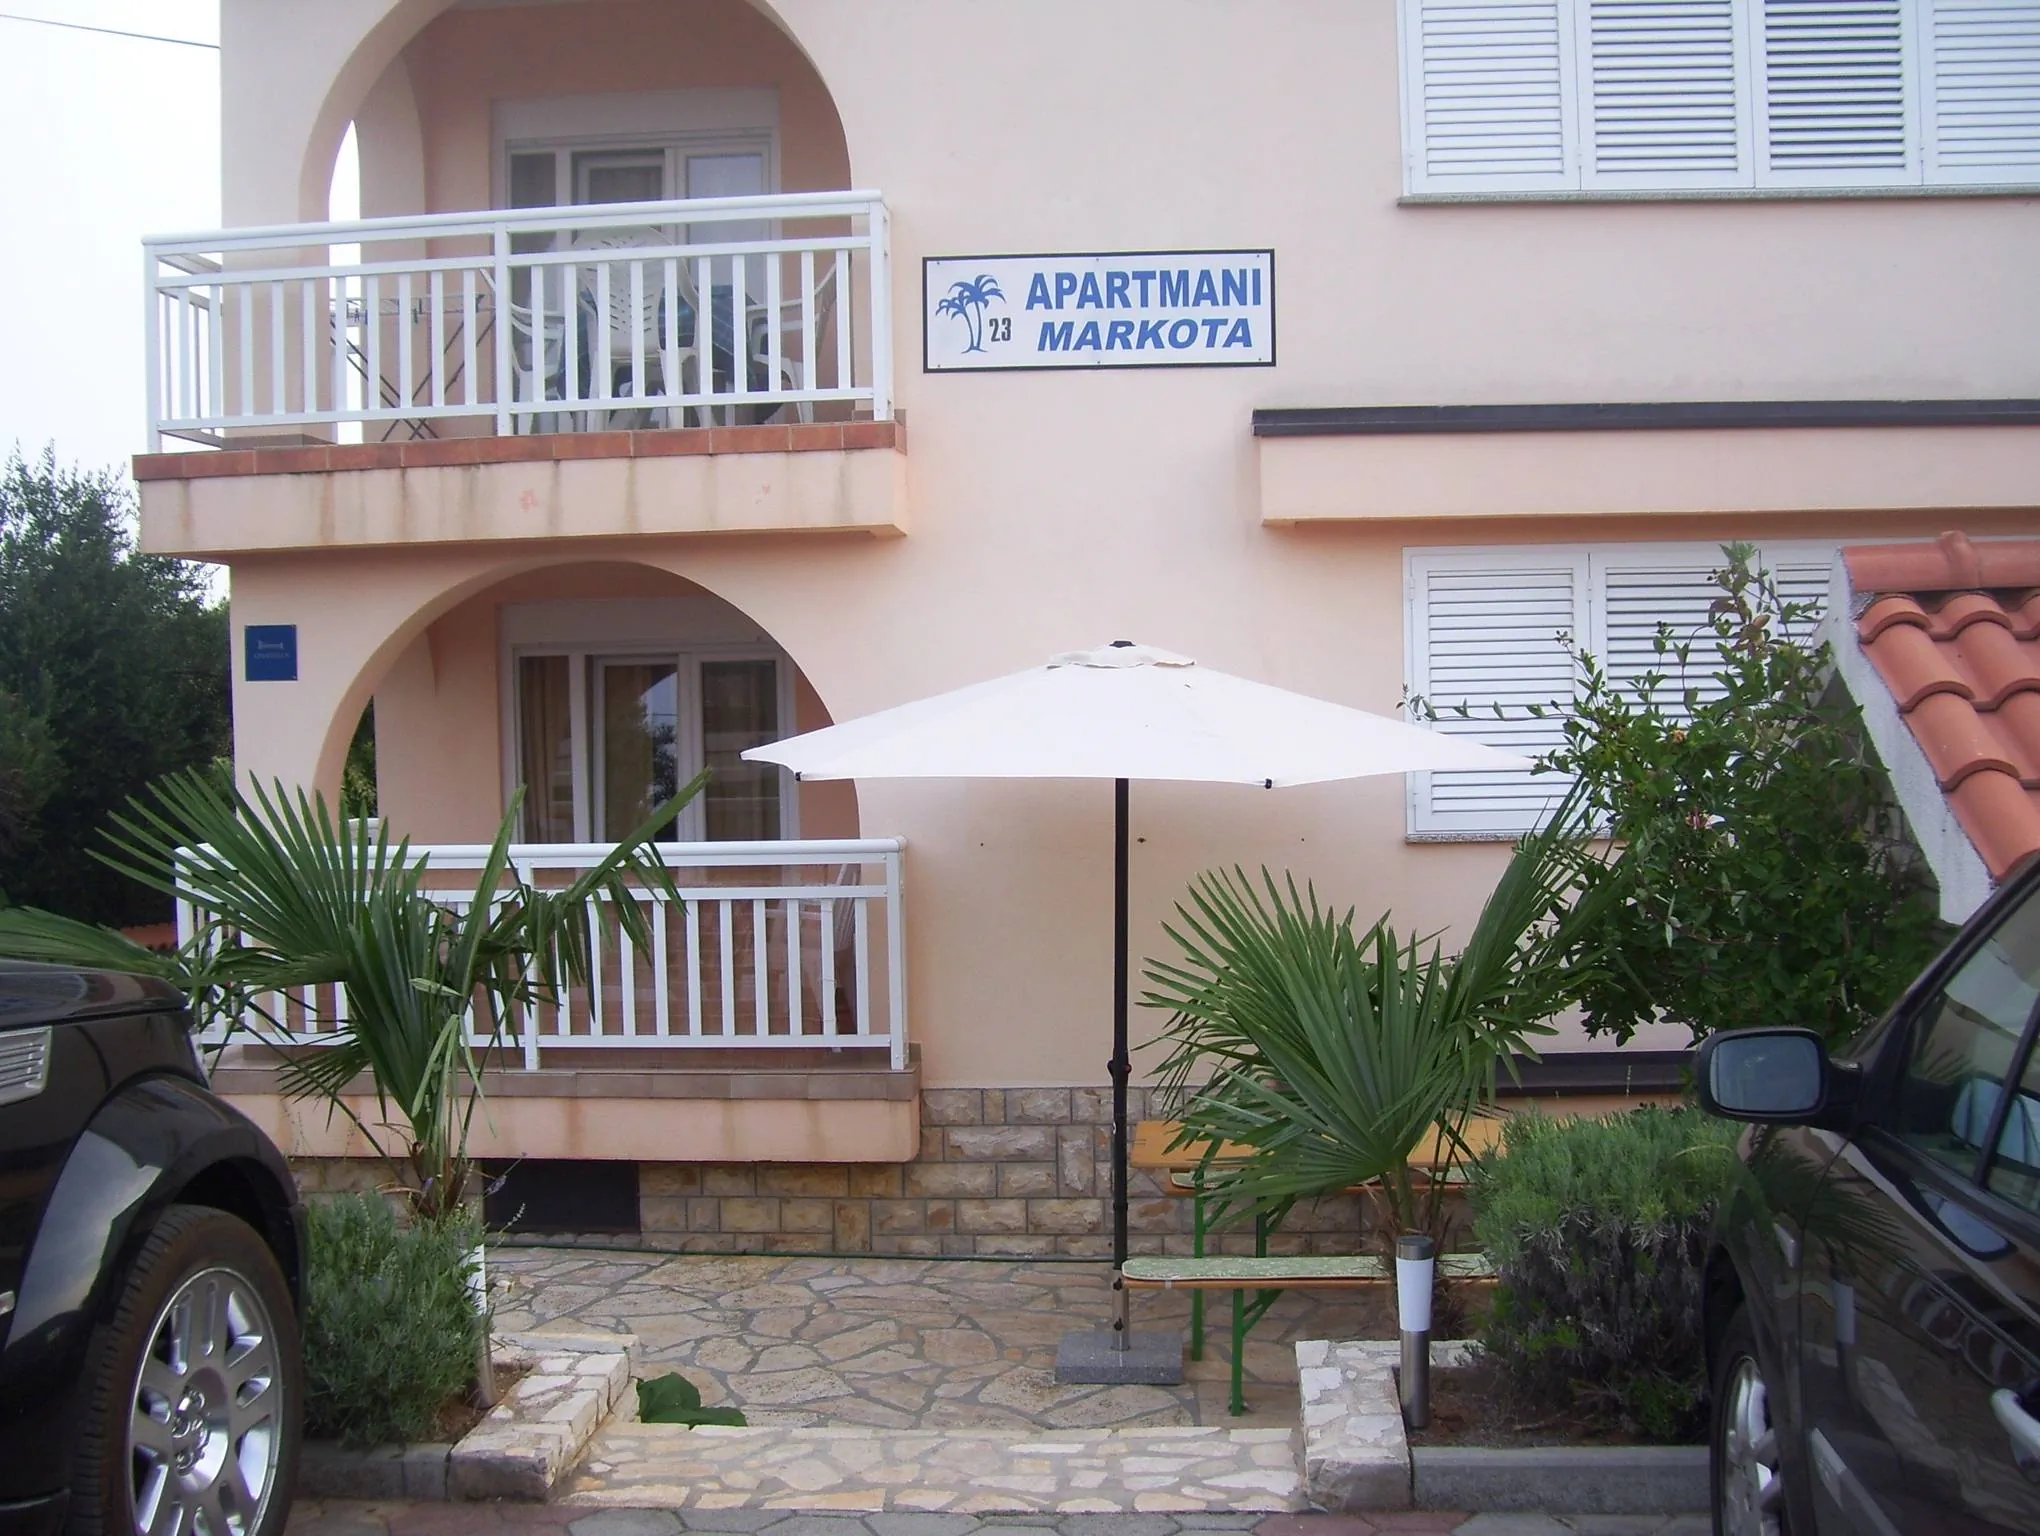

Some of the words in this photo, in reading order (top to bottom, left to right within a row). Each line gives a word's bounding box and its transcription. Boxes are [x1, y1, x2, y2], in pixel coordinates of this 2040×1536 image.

[1025, 268, 1262, 310] APARTMANI
[988, 317, 1012, 342] 23
[1037, 318, 1253, 351] MARKOTA
